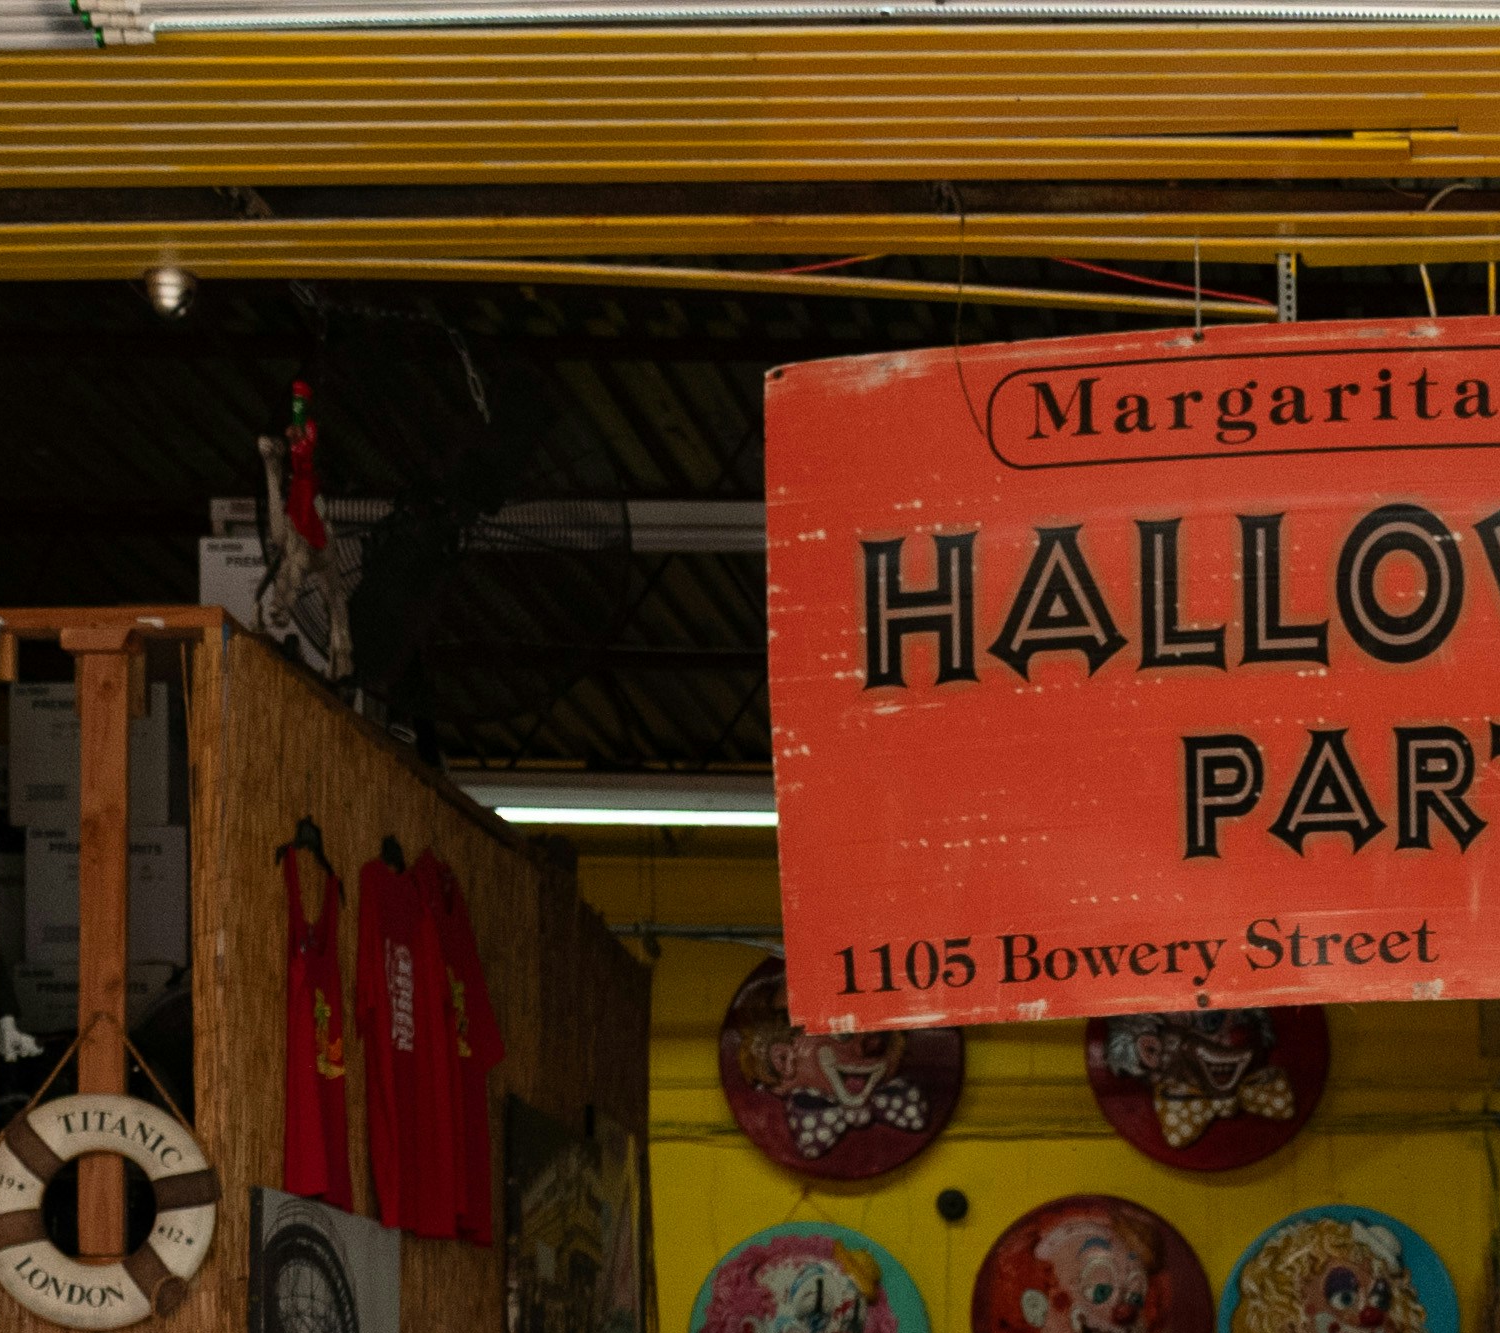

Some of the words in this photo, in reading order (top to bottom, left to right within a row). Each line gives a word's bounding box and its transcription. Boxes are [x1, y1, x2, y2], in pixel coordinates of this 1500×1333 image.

[1024, 364, 1500, 445] Margarita
[836, 933, 977, 996] 1105
[999, 930, 1226, 990] Bowery
[1244, 916, 1439, 968] Street
[57, 1110, 182, 1169] TITANIC
[14, 1256, 125, 1307] LONDON
